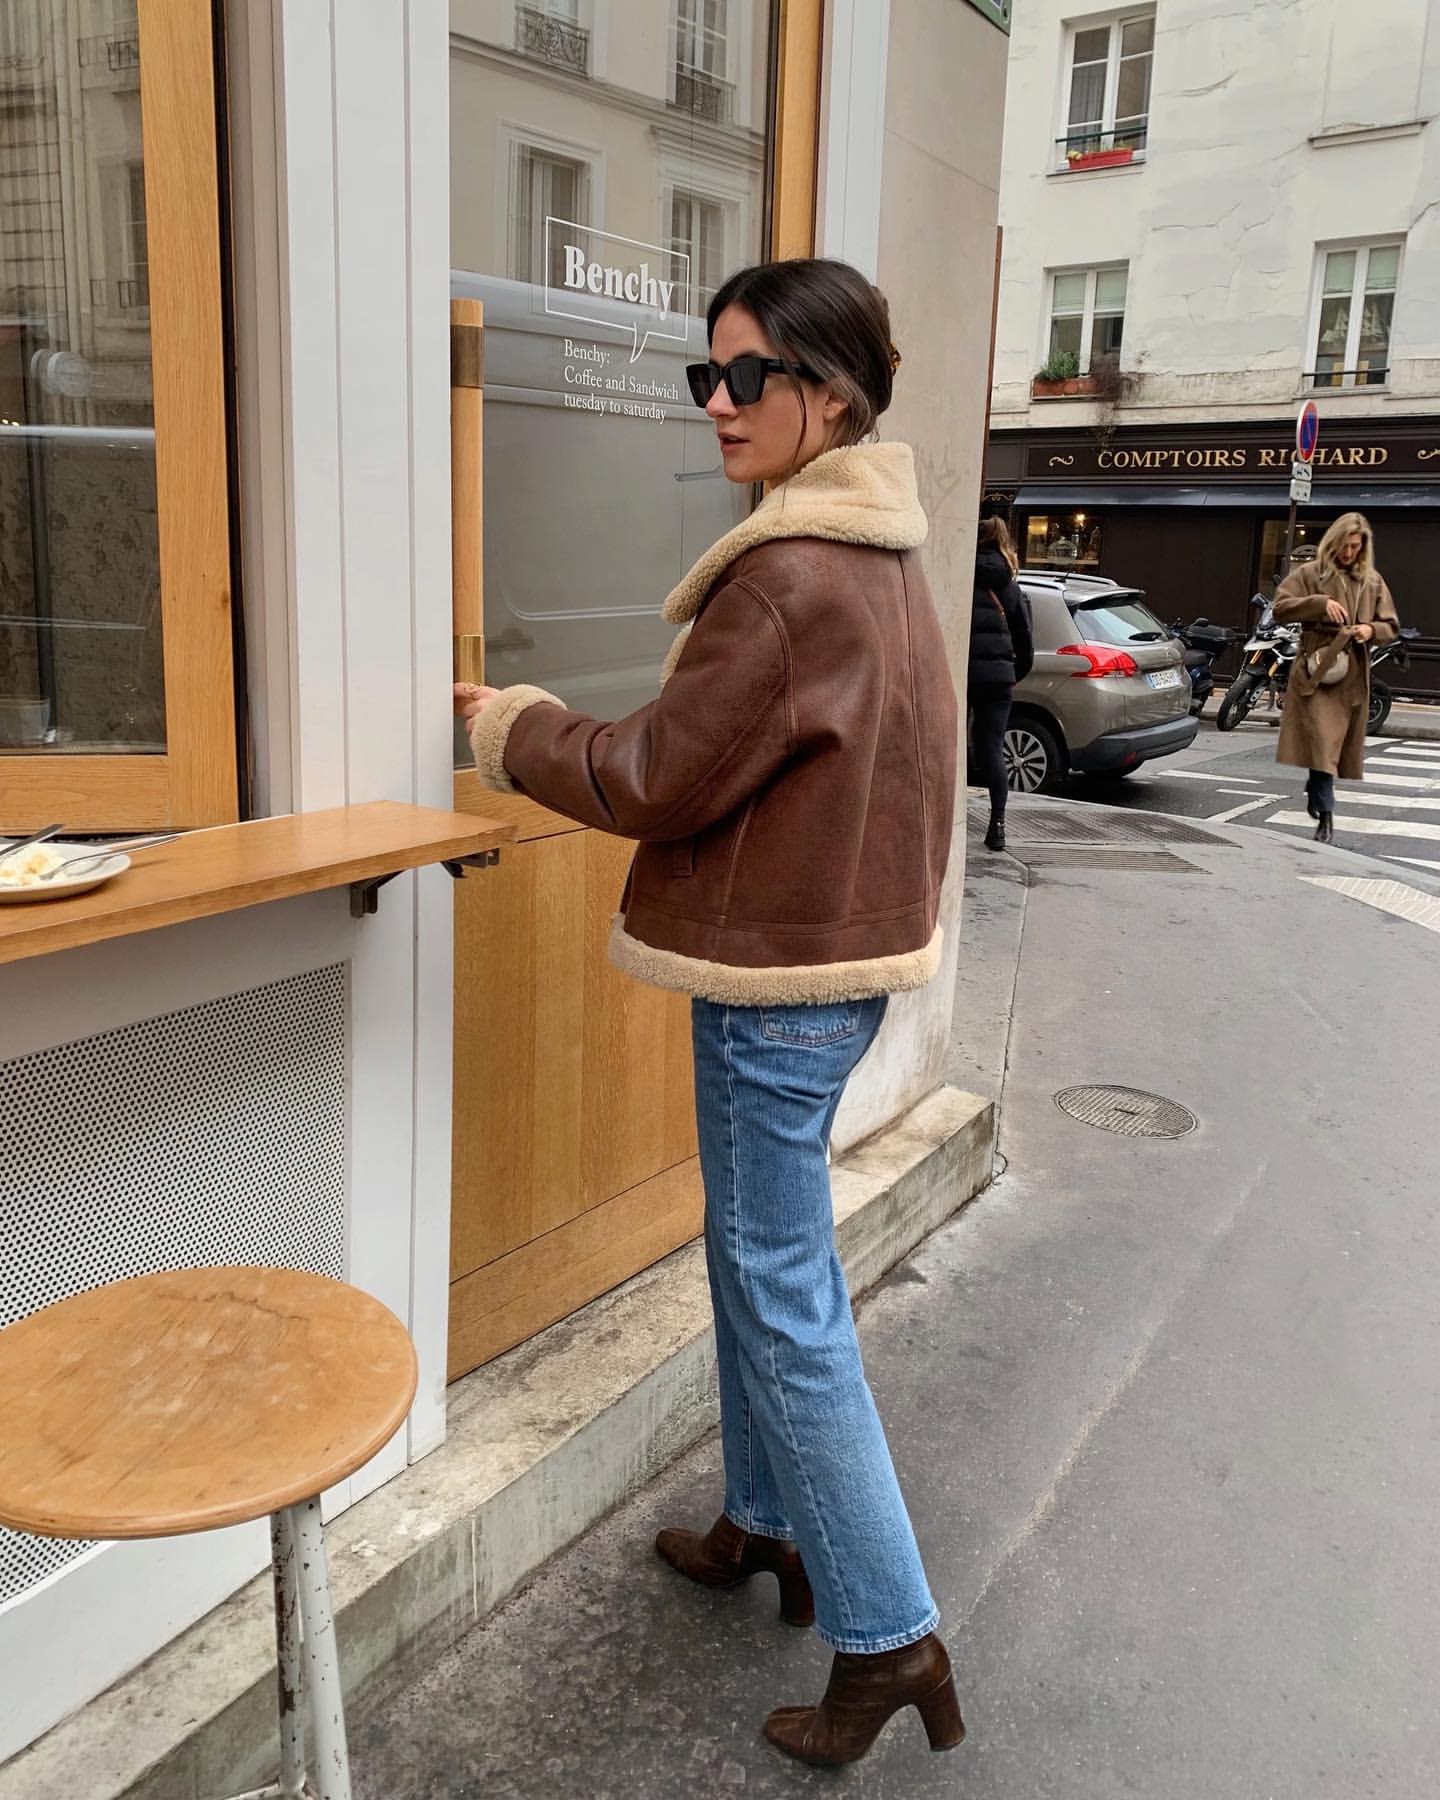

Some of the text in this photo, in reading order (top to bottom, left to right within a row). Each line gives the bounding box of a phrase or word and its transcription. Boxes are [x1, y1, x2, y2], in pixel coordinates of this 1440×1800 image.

[563, 244, 675, 321] Benchy
[564, 338, 611, 368] Benchy:
[564, 365, 680, 401] Coffee and Sandwich
[564, 392, 666, 425] tuesday to saturday
[1097, 448, 1247, 469] COMPTOIRS
